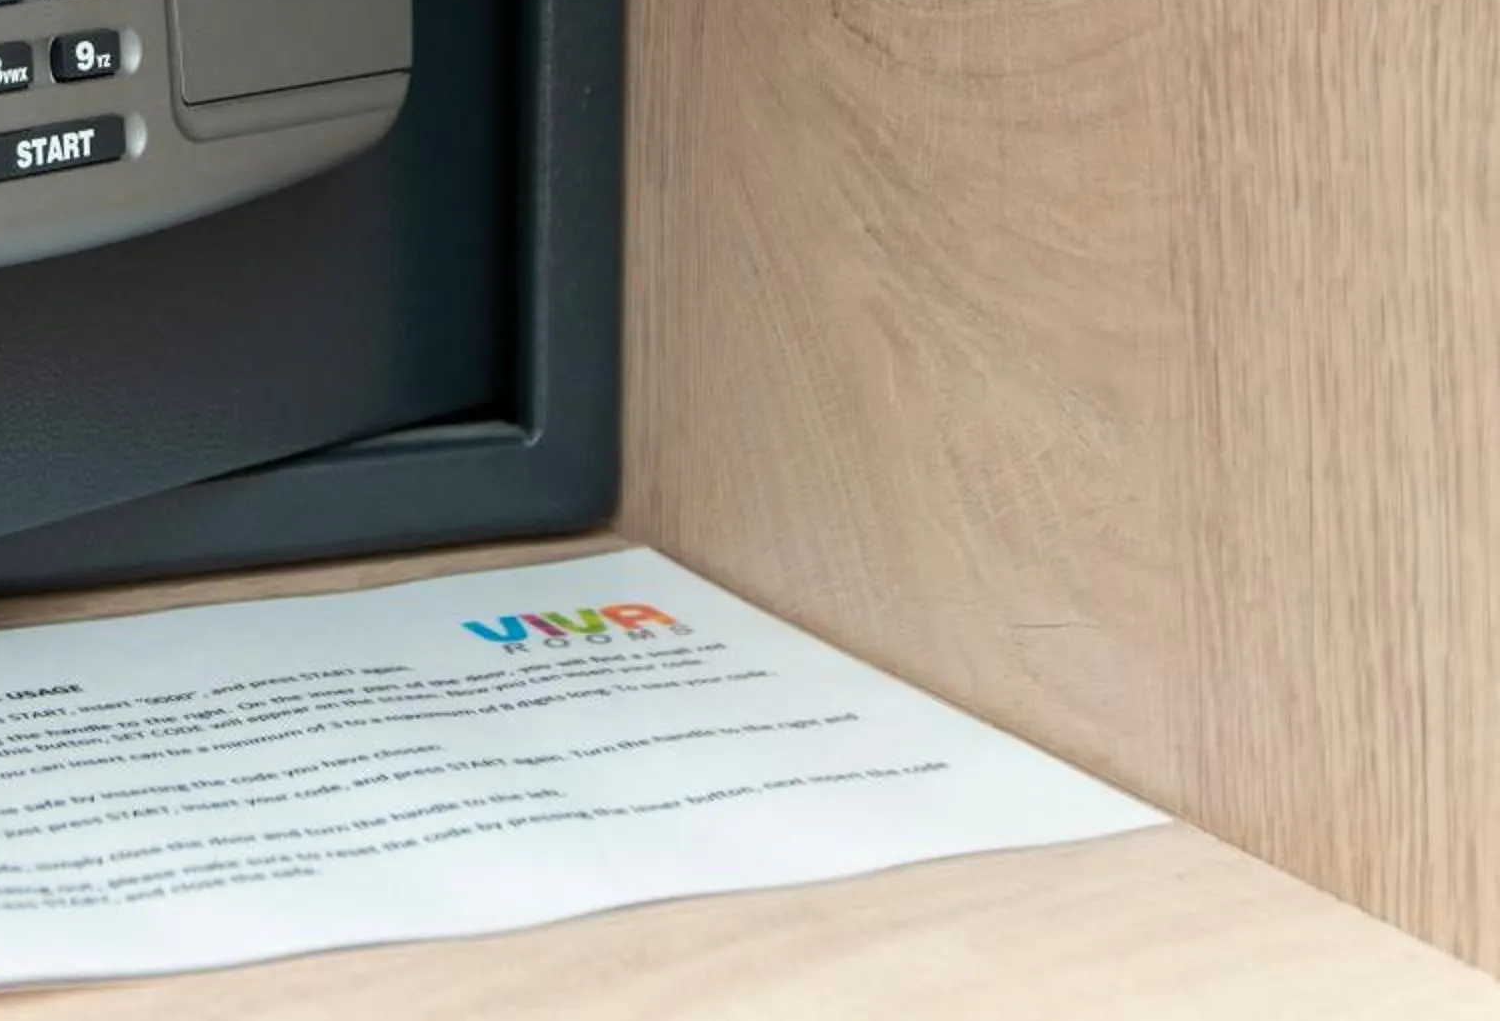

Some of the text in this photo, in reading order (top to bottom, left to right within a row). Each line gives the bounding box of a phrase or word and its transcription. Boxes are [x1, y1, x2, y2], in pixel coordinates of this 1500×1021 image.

[17, 129, 94, 168] START
[461, 602, 678, 644] VIVA
[500, 624, 694, 655] ROOMS
[5, 684, 83, 700] USAGE
